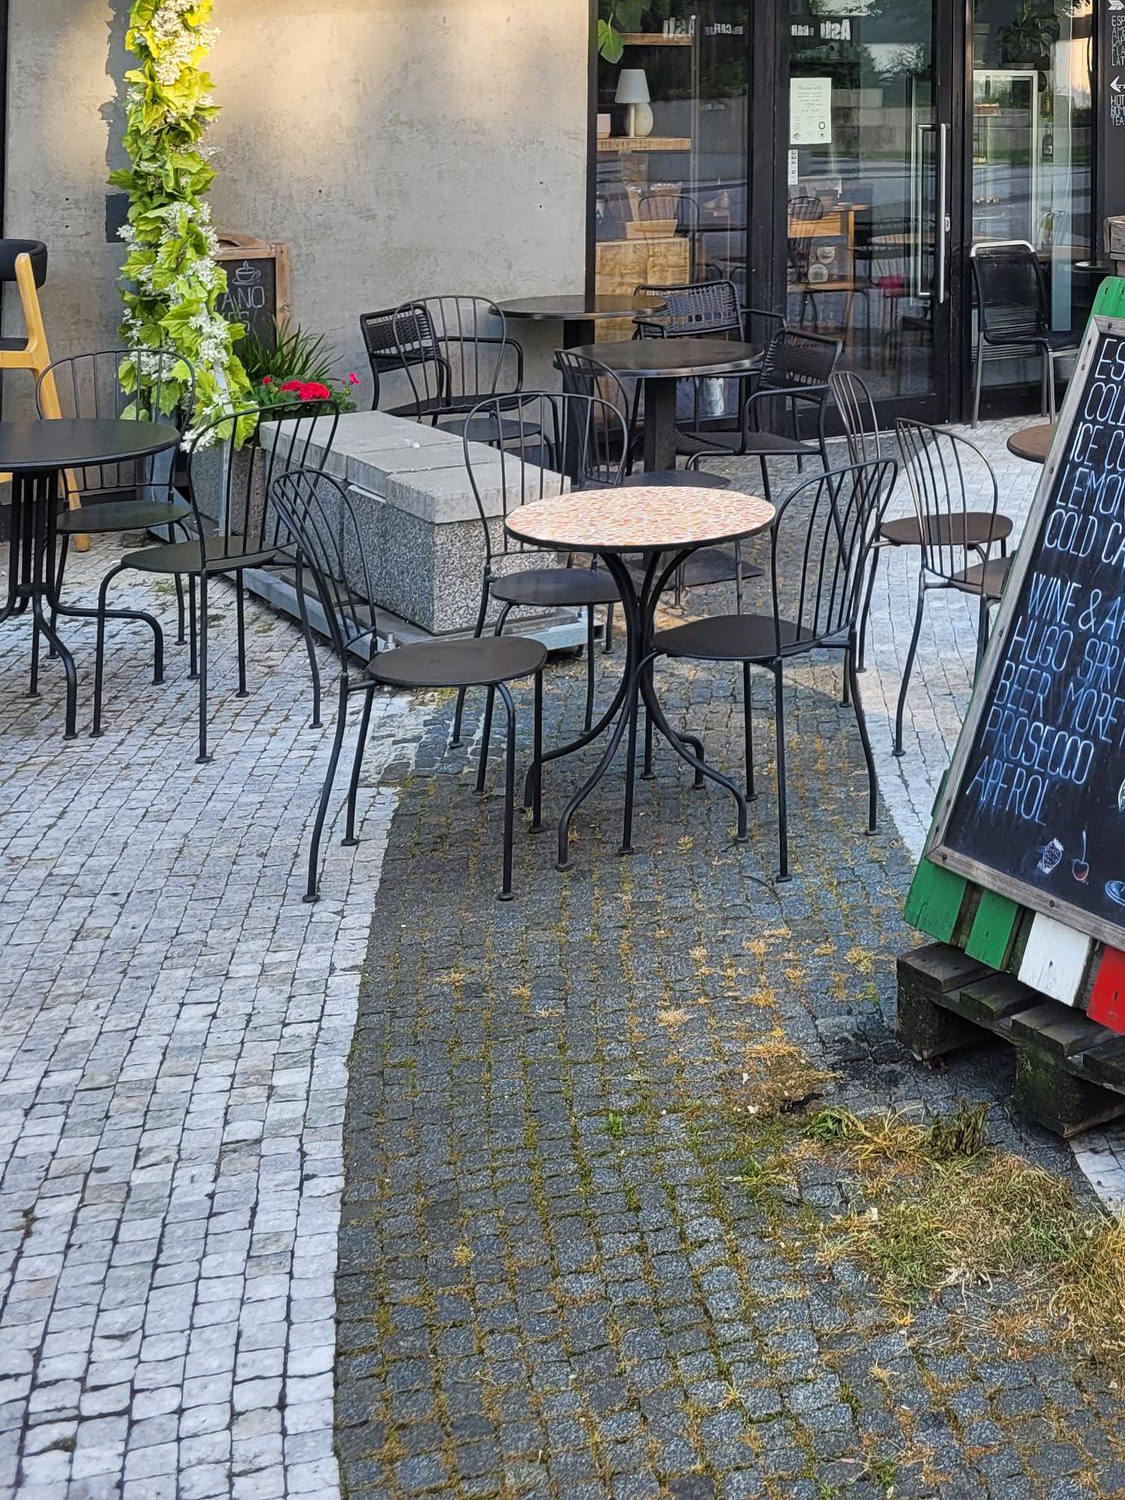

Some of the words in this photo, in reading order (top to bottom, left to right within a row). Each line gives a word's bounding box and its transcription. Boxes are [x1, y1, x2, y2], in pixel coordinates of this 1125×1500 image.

[1110, 94, 1125, 106] HOT
[1069, 422, 1105, 468] ICE
[1045, 508, 1097, 557] COLD
[1027, 571, 1082, 627] WINE
[1078, 589, 1104, 631] &
[1007, 616, 1074, 673] HUGO
[993, 660, 1052, 719] BEER
[979, 707, 1094, 786] PROSECCO
[966, 756, 1050, 827] APEROL
